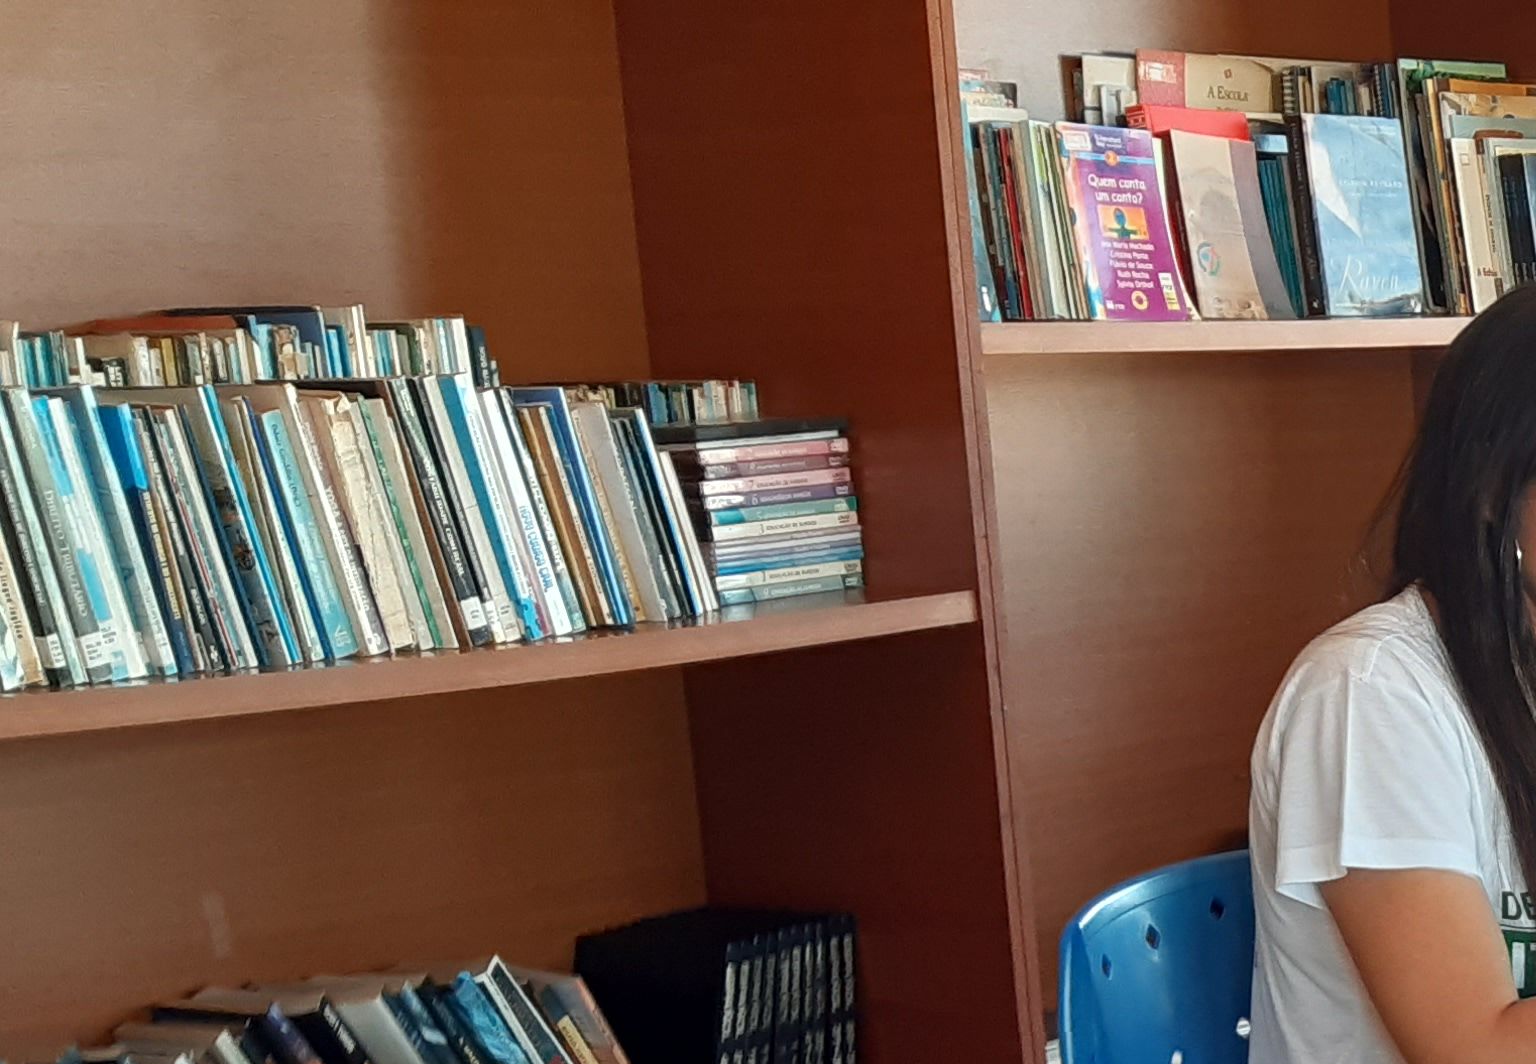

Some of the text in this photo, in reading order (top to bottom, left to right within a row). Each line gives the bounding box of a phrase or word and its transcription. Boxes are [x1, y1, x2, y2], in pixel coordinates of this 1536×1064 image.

[1088, 174, 1146, 189] Quem conta
[1095, 191, 1143, 204] um conto?
